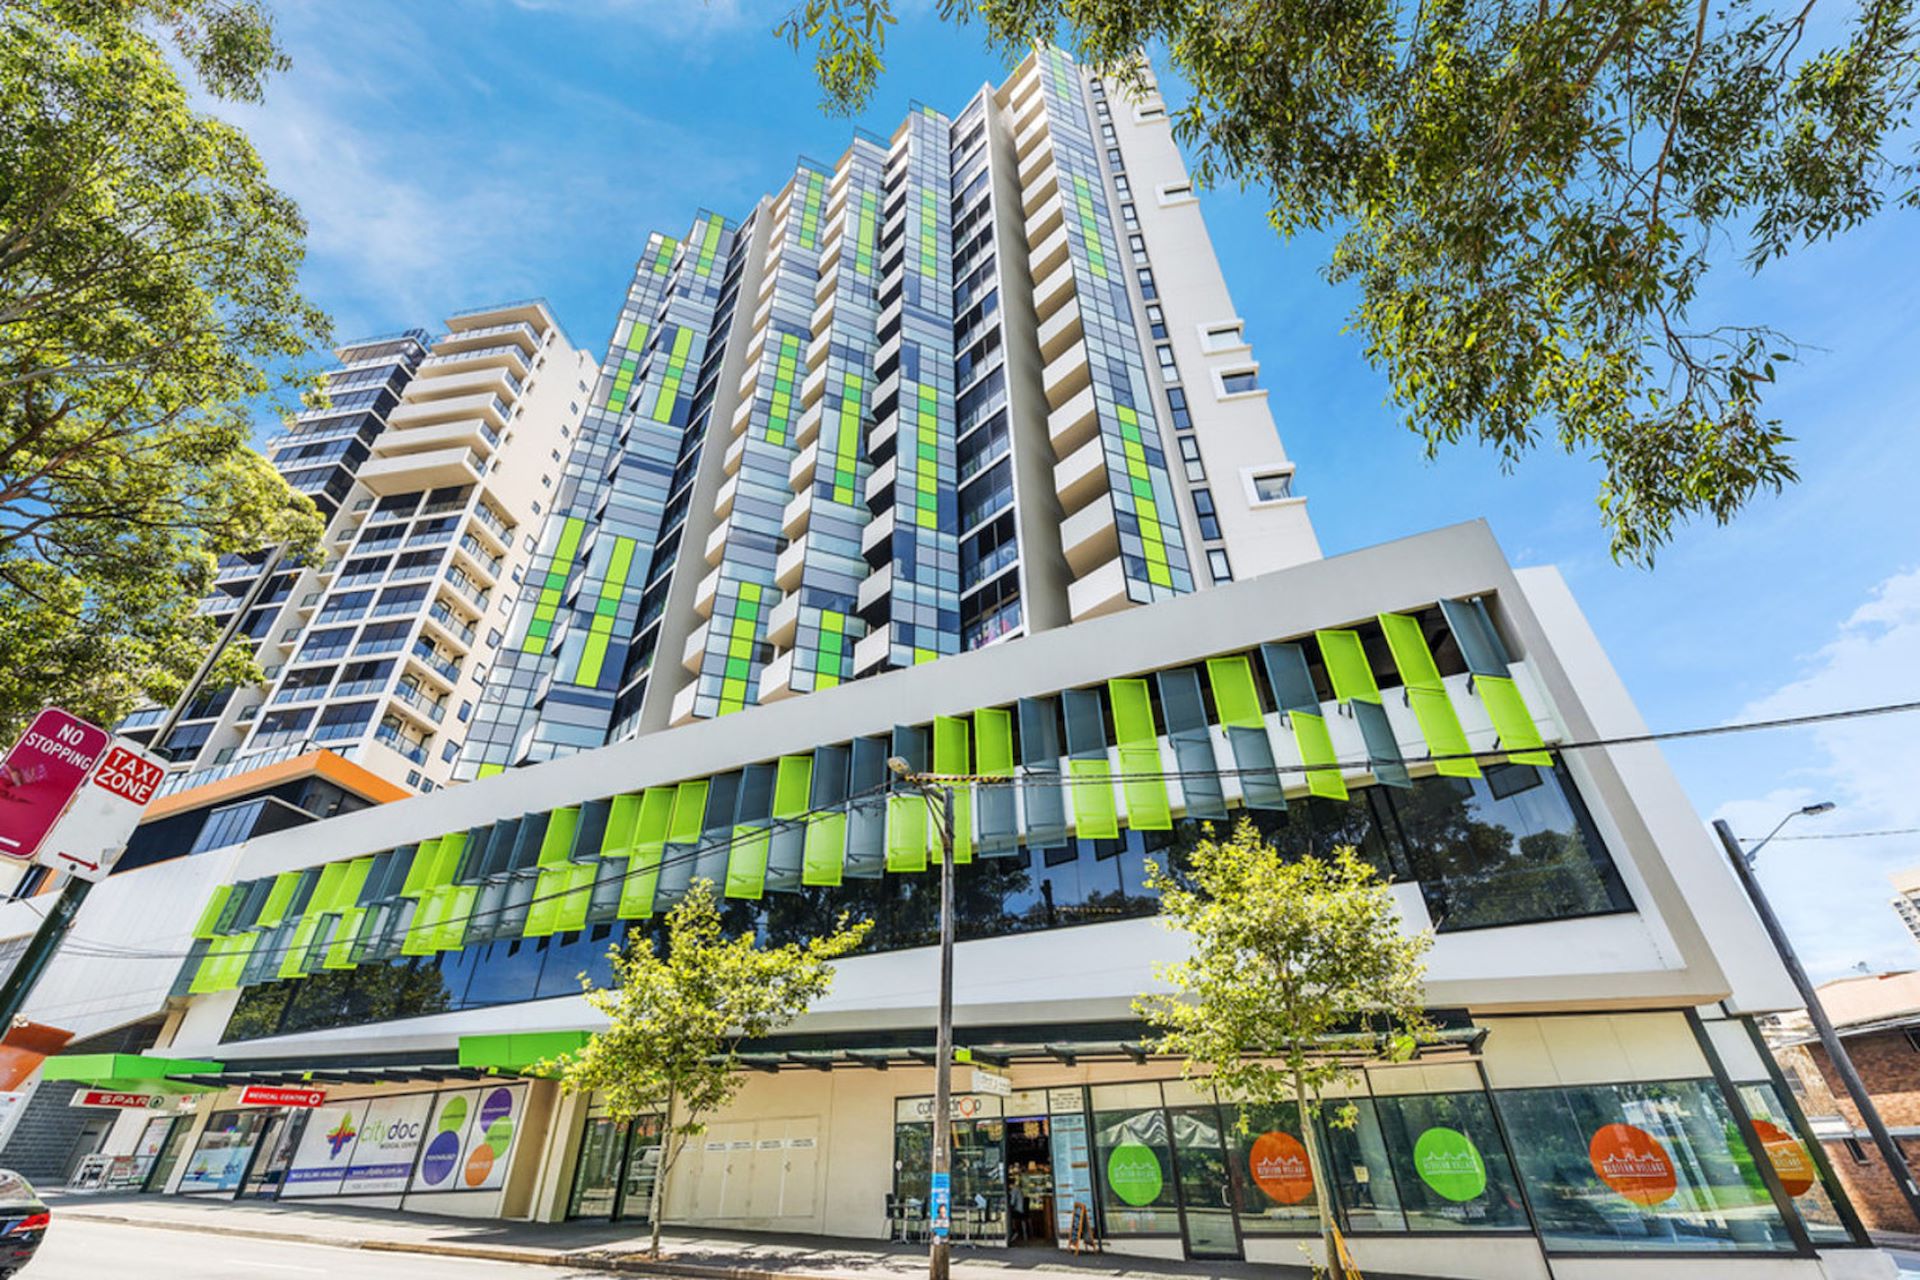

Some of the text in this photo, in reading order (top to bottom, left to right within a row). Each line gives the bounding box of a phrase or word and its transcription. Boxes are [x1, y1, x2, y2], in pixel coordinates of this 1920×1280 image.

[57, 723, 85, 746] NO
[25, 731, 93, 771] STOPPING
[113, 749, 162, 785] TAXI
[96, 766, 153, 802] ZONE
[98, 1094, 147, 1107] SPAR
[248, 1091, 308, 1102] MEDICAL CENTRE
